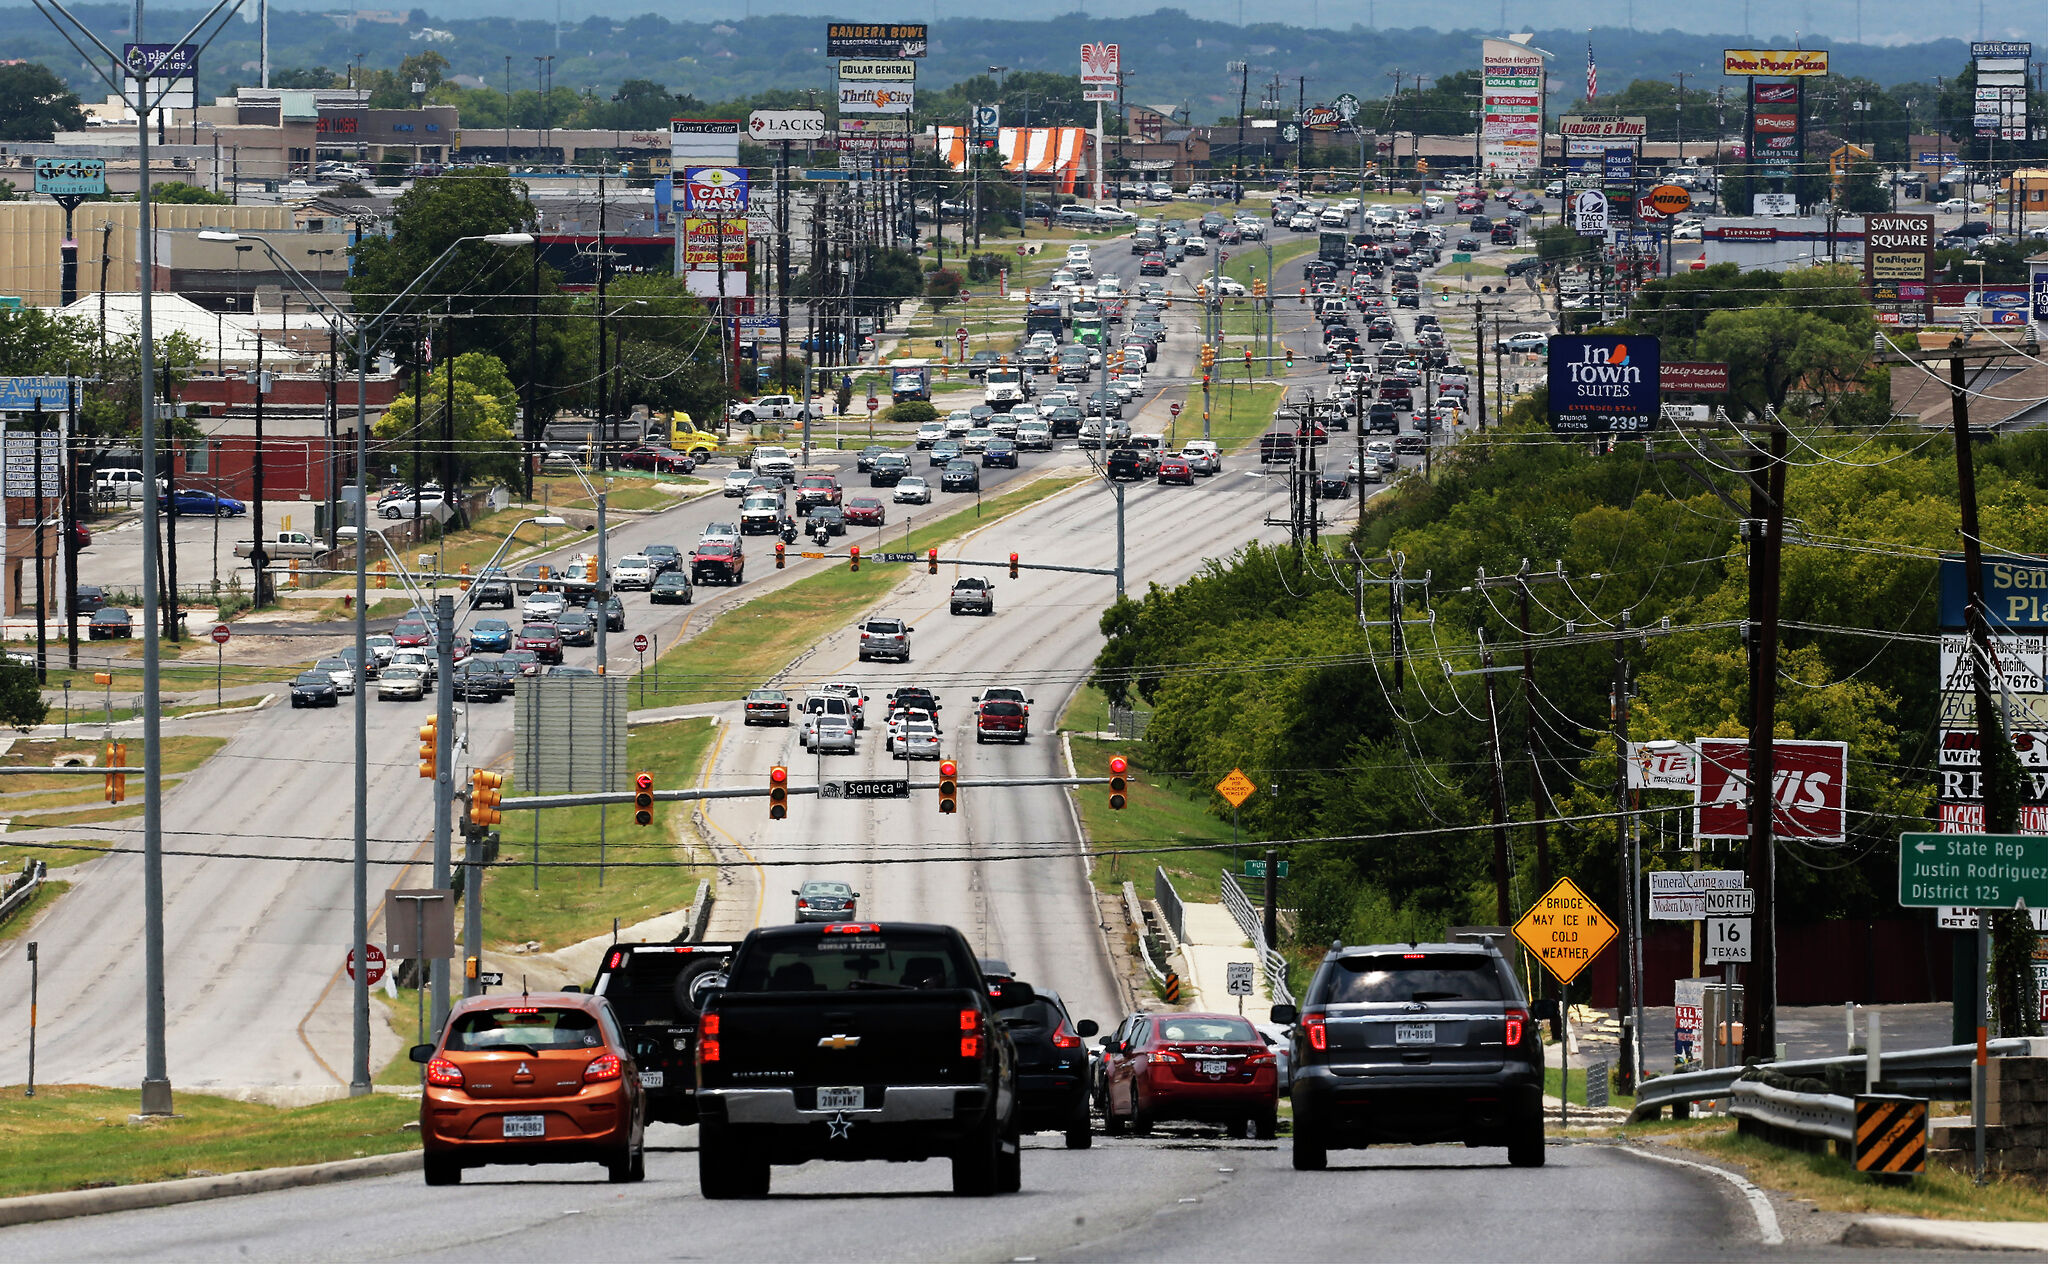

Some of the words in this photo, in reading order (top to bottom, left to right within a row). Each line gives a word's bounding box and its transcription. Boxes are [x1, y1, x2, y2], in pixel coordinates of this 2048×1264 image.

[830, 26, 886, 37] BANDERA
[890, 26, 924, 38] BOWL
[1973, 43, 2000, 51] CLEAR
[2001, 43, 2029, 51] CREEK
[153, 60, 193, 70] ftness
[842, 65, 873, 74] DOLLAR
[875, 65, 912, 74] GENERAL
[1726, 57, 1759, 70] Peter
[1760, 58, 1793, 71] Piper
[1794, 58, 1826, 70] Pizza
[840, 89, 875, 104] Thrift
[889, 91, 912, 104] City
[1302, 109, 1340, 128] Cane's
[1763, 118, 1795, 128] Payless
[316, 118, 330, 133] BBY
[676, 123, 702, 133] Town
[704, 123, 735, 133] Center
[769, 119, 824, 131] LACKS
[1562, 123, 1600, 134] LIQUOR
[1603, 124, 1613, 134] &
[1615, 121, 1645, 134] WINE
[840, 139, 873, 149] TUESDAY
[698, 188, 736, 199] CAR
[1653, 194, 1689, 205] MIDAS
[691, 200, 744, 211] WASH
[1580, 213, 1604, 221] TACO
[1871, 218, 1928, 231] SAVINGS
[689, 235, 706, 243] AUTO
[708, 235, 744, 243] INSRANCE
[1871, 235, 1928, 248] SQUARE
[1583, 344, 1612, 365] In
[1567, 362, 1641, 384] Town
[1660, 366, 1726, 377] Walgreens
[1577, 385, 1630, 397] SUITES
[1609, 416, 1638, 430] 239
[1993, 564, 2048, 589] Sen
[2026, 638, 2040, 654] MD
[1990, 656, 2026, 672] edicine
[1947, 697, 2027, 718] Fual
[2029, 752, 2041, 764] &
[849, 783, 894, 795] Seneca
[1947, 841, 1987, 856] State
[1995, 842, 2024, 860] Rep
[1913, 862, 1960, 877] Justin
[1968, 863, 2048, 882] Rodriguez
[1652, 874, 1686, 889] Funeral
[1687, 874, 1716, 890] Caring
[1726, 878, 1743, 889] USA
[1912, 884, 1968, 899] District
[1976, 885, 2000, 900] 125
[1546, 897, 1583, 909] BRIDGE
[1653, 899, 1679, 912] Modern
[1680, 899, 1693, 915] Day
[1707, 894, 1751, 908] NORTH
[1532, 914, 1555, 926] MAY
[1563, 914, 1579, 926] ICE
[1587, 915, 1598, 926] IN
[1942, 918, 1965, 927] PET
[1552, 931, 1578, 943] COLD
[1718, 922, 1741, 943] 16
[1542, 947, 1589, 959] WEATHER
[1712, 947, 1747, 957] TEXAS
[1230, 980, 1251, 992] 45
